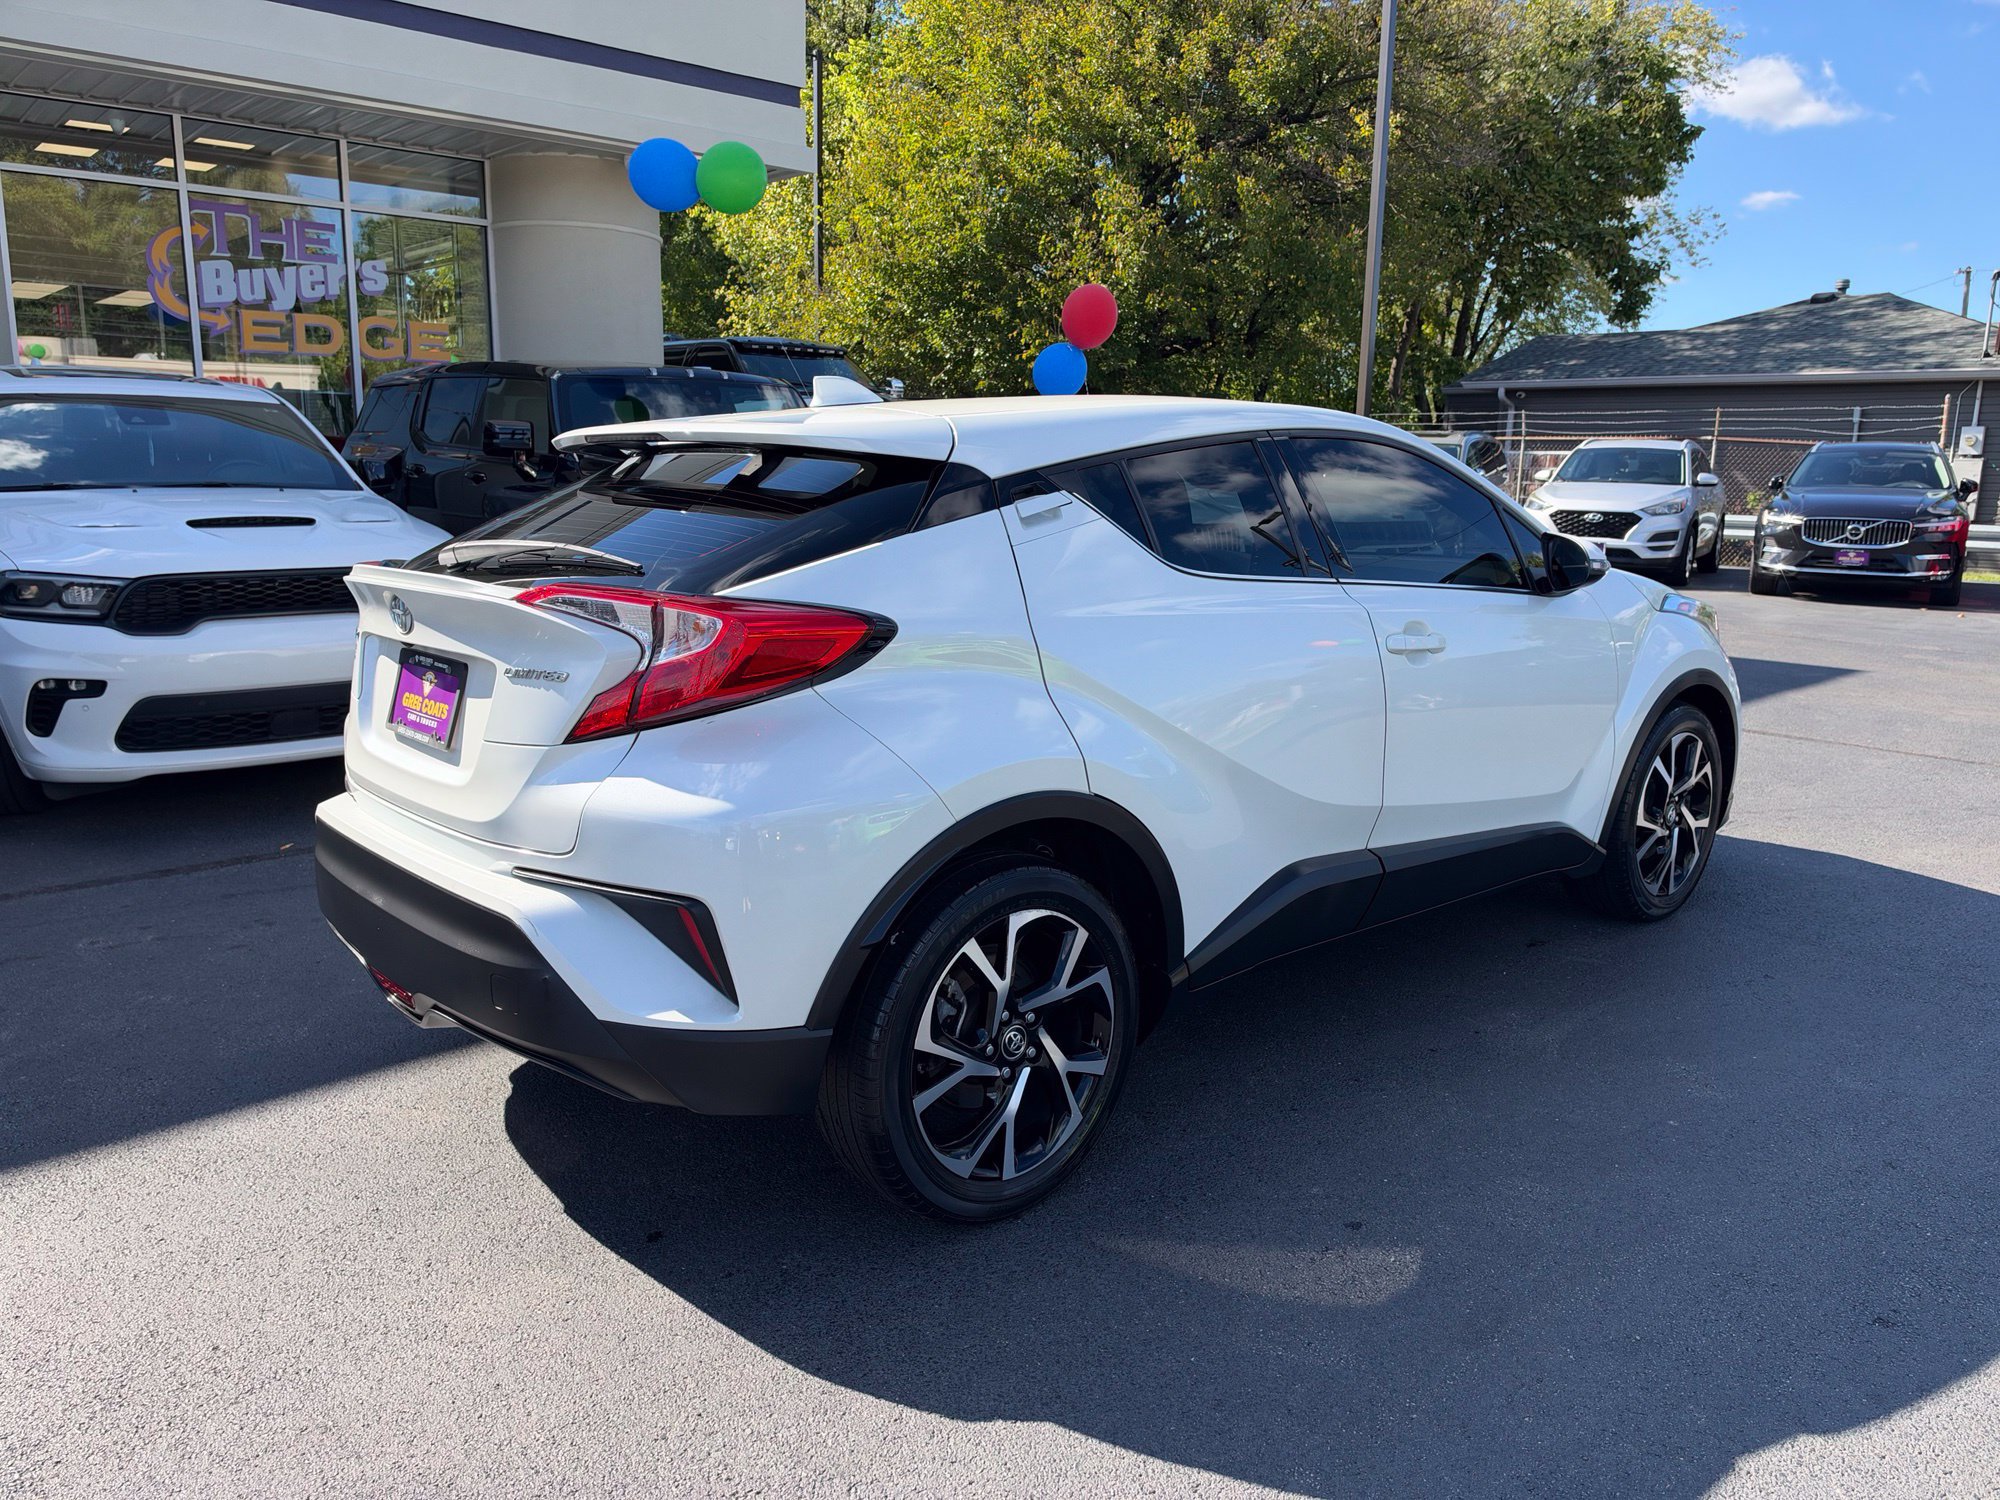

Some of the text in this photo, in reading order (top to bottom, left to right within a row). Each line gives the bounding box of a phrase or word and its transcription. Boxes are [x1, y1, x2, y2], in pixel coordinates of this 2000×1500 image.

[189, 199, 339, 265] THE
[198, 258, 390, 312] Buyer's
[238, 309, 452, 363] EDGE
[402, 691, 449, 719] GREG COATS
[407, 712, 417, 721] CARS
[420, 717, 438, 728] TRUCKS
